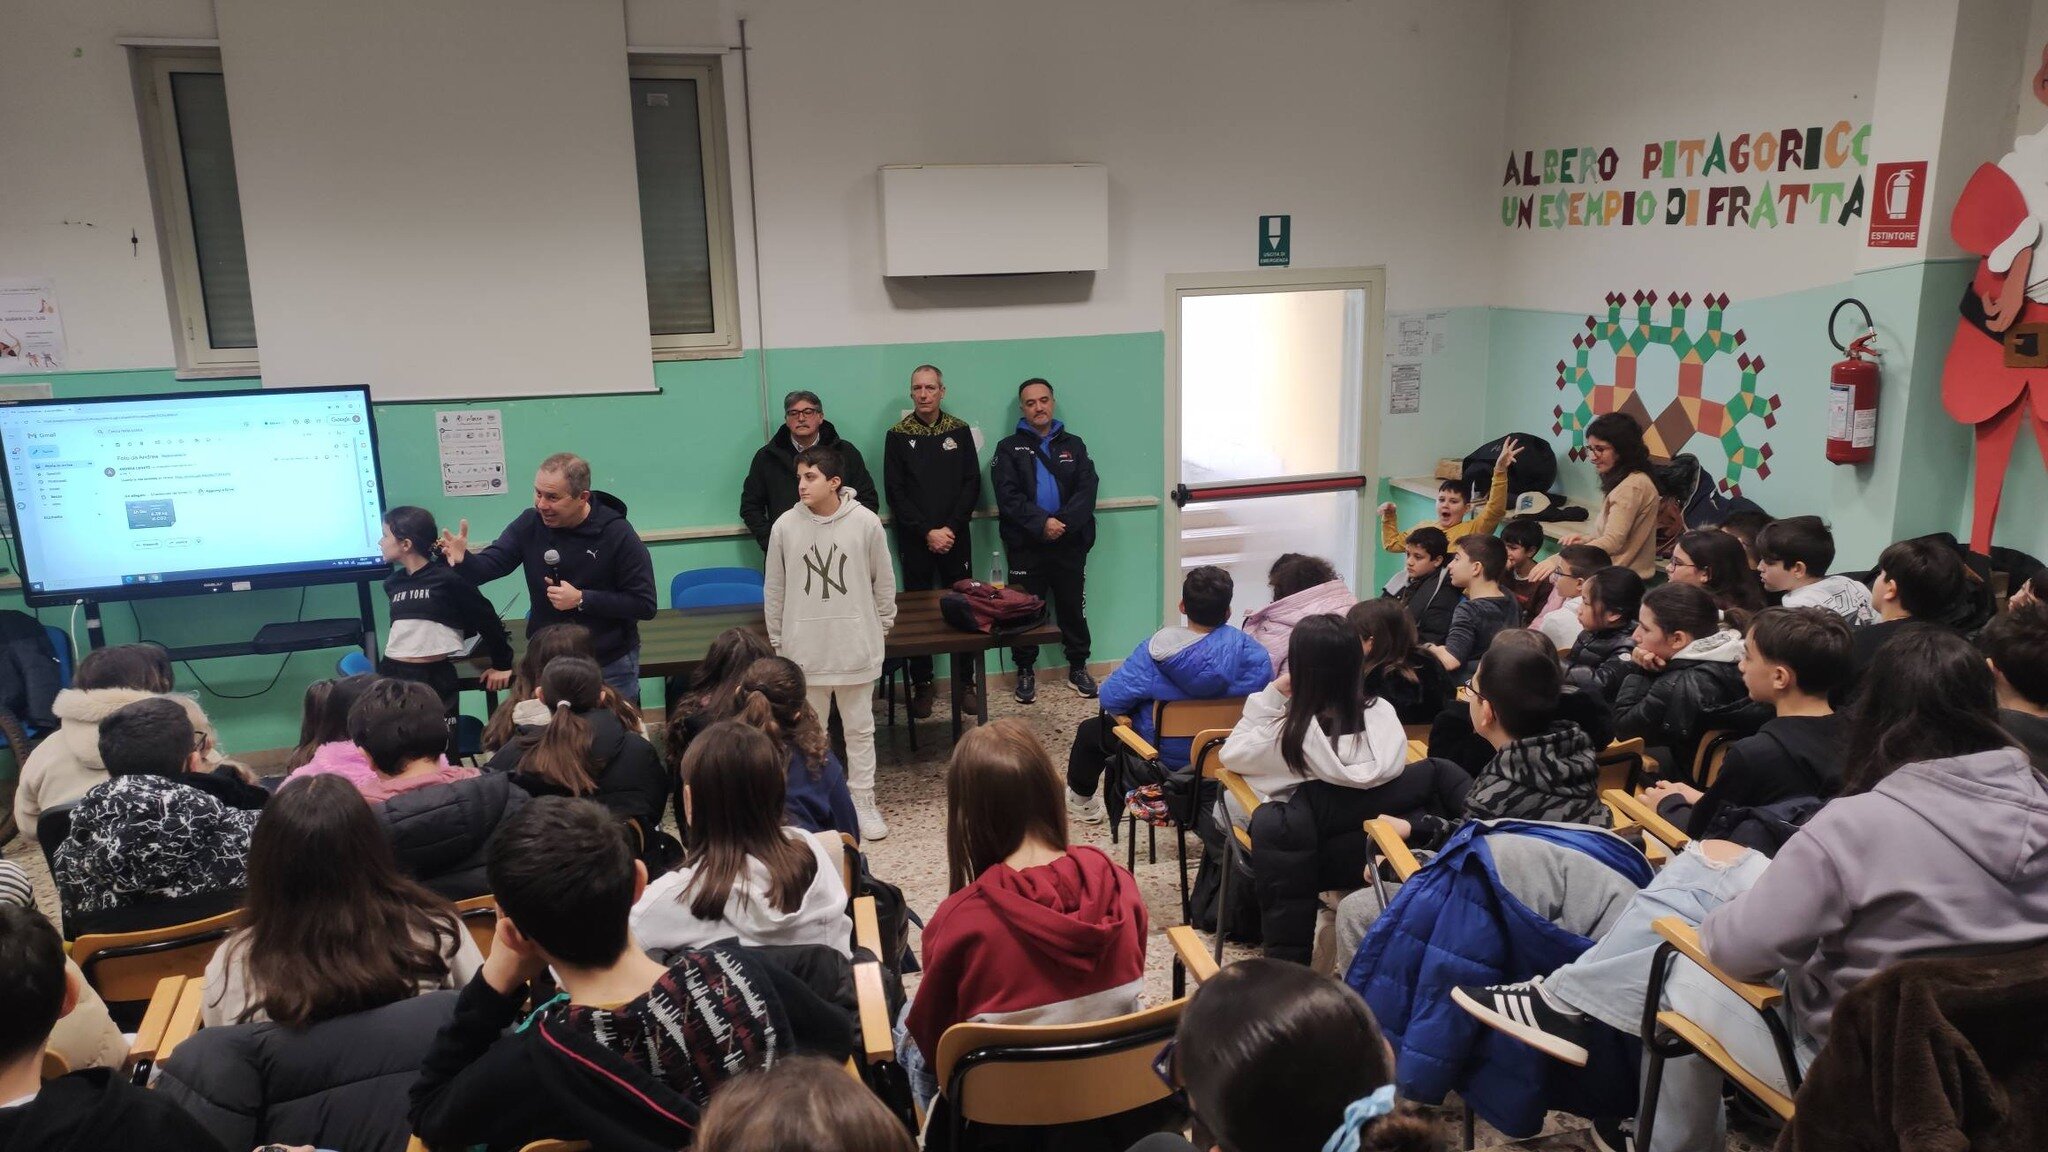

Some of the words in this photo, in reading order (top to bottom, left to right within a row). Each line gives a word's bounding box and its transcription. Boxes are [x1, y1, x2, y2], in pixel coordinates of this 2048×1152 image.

[1502, 147, 1619, 187] ALBERO
[1665, 188, 1700, 227] DI
[1871, 231, 1916, 240] ESTINTORE
[802, 542, 848, 599] NY
[392, 591, 407, 603] NEW
[409, 589, 430, 600] YORK
